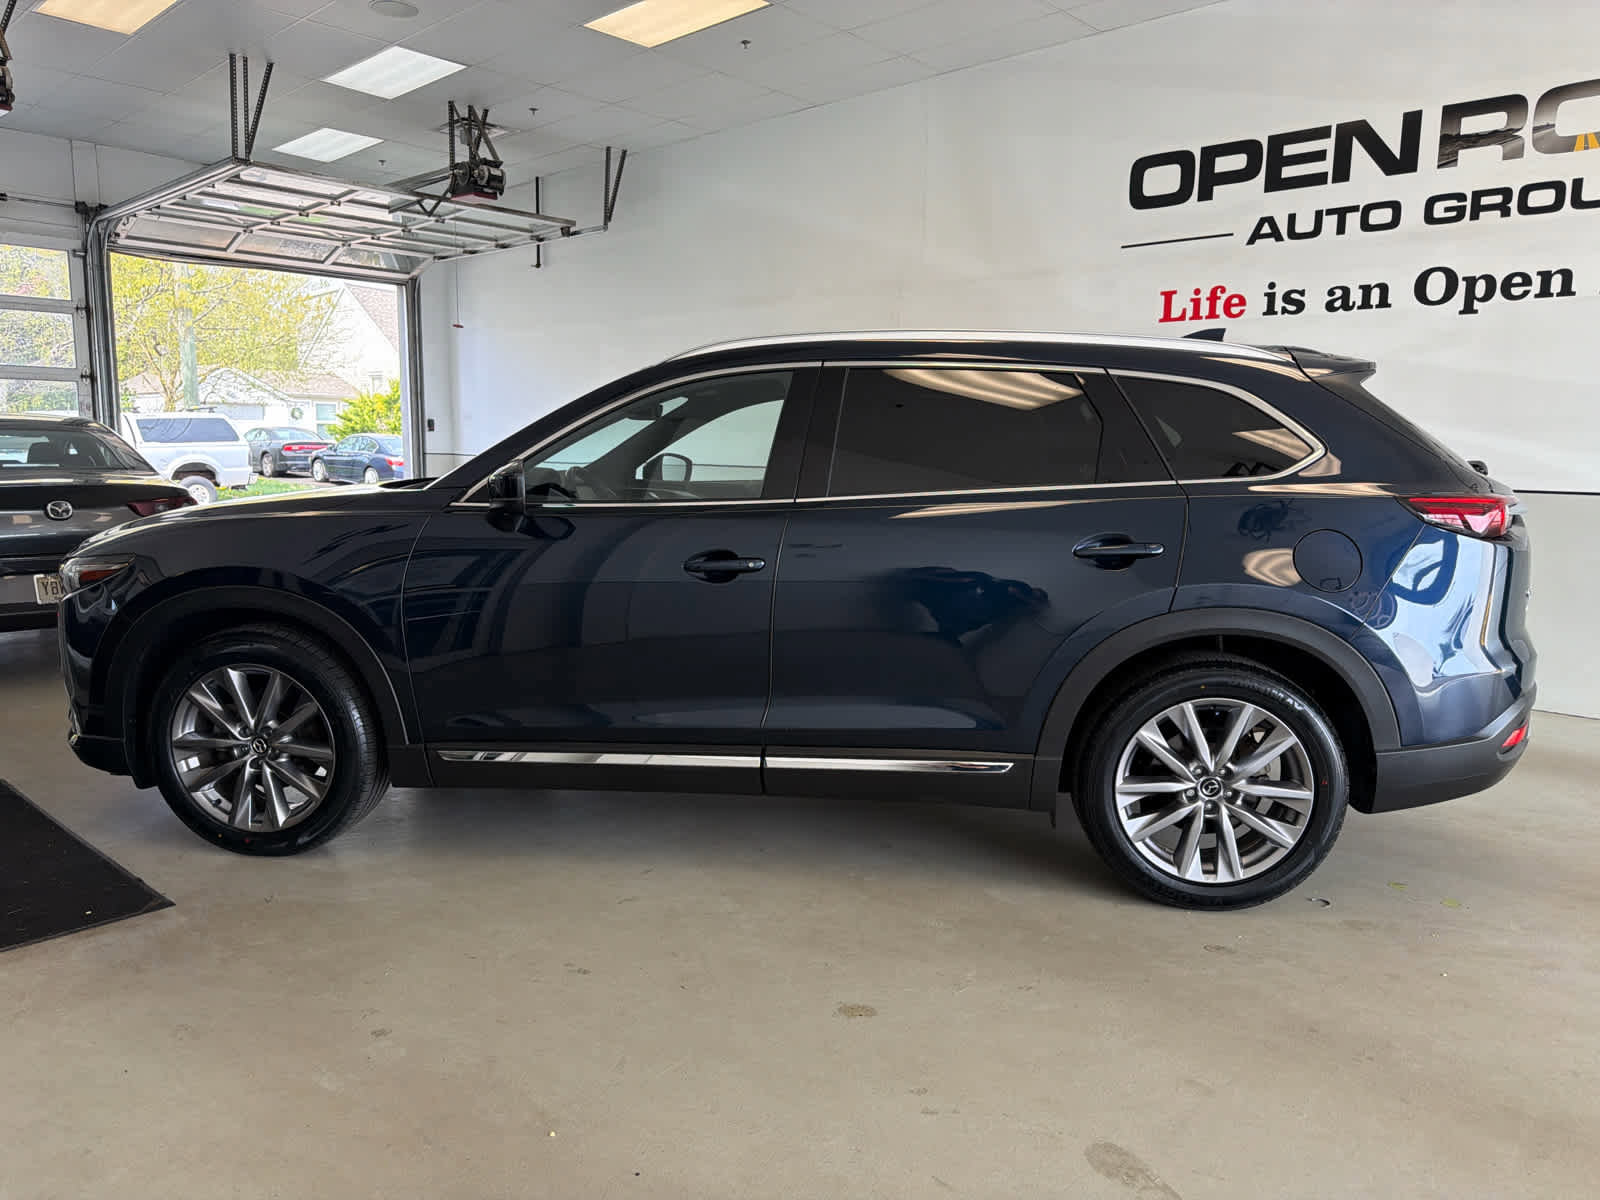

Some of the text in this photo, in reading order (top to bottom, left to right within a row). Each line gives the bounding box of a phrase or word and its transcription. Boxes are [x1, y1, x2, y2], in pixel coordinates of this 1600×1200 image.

[1128, 109, 1424, 211] OPEN
[1245, 199, 1402, 246] AUTO
[1158, 266, 1577, 323] Life is an Open
